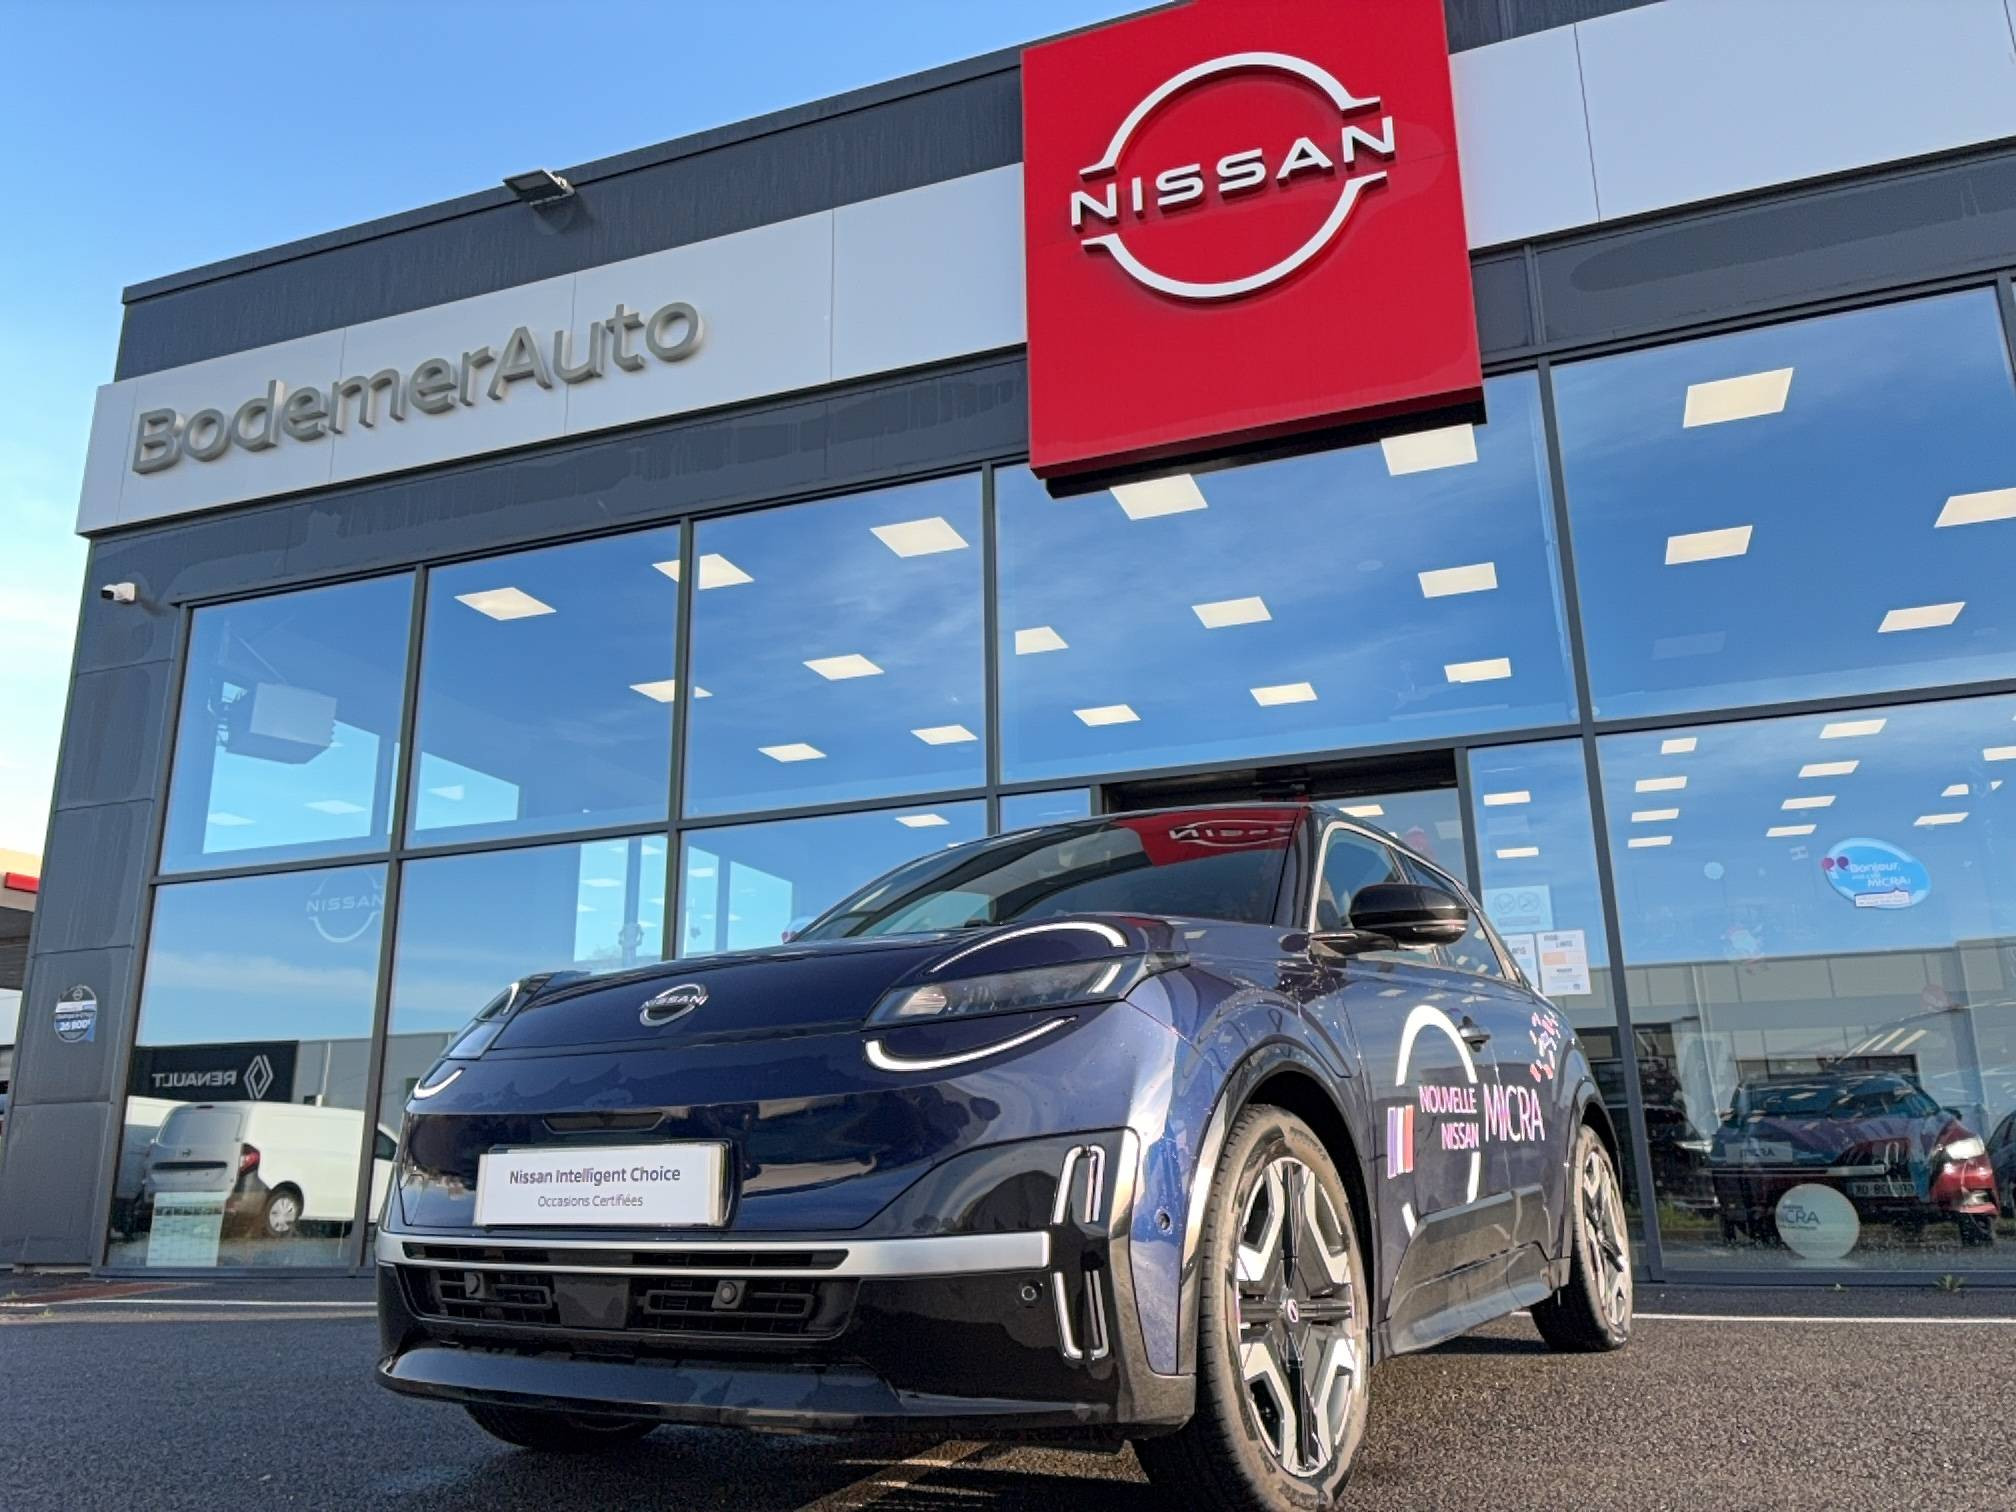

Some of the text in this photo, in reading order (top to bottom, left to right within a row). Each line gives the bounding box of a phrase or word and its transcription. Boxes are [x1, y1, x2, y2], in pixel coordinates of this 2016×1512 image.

[1071, 115, 1396, 231] NISSAN
[132, 303, 704, 474] BodemerAuto
[306, 894, 384, 912] NISSAN
[1418, 1085, 1477, 1114] NOUVELLE
[1483, 1083, 1545, 1142] MICRA
[1441, 1122, 1479, 1150] NISSAN
[509, 1165, 681, 1186] Nissan Intelligent Choice
[537, 1193, 643, 1208] Occasions Certifiées
